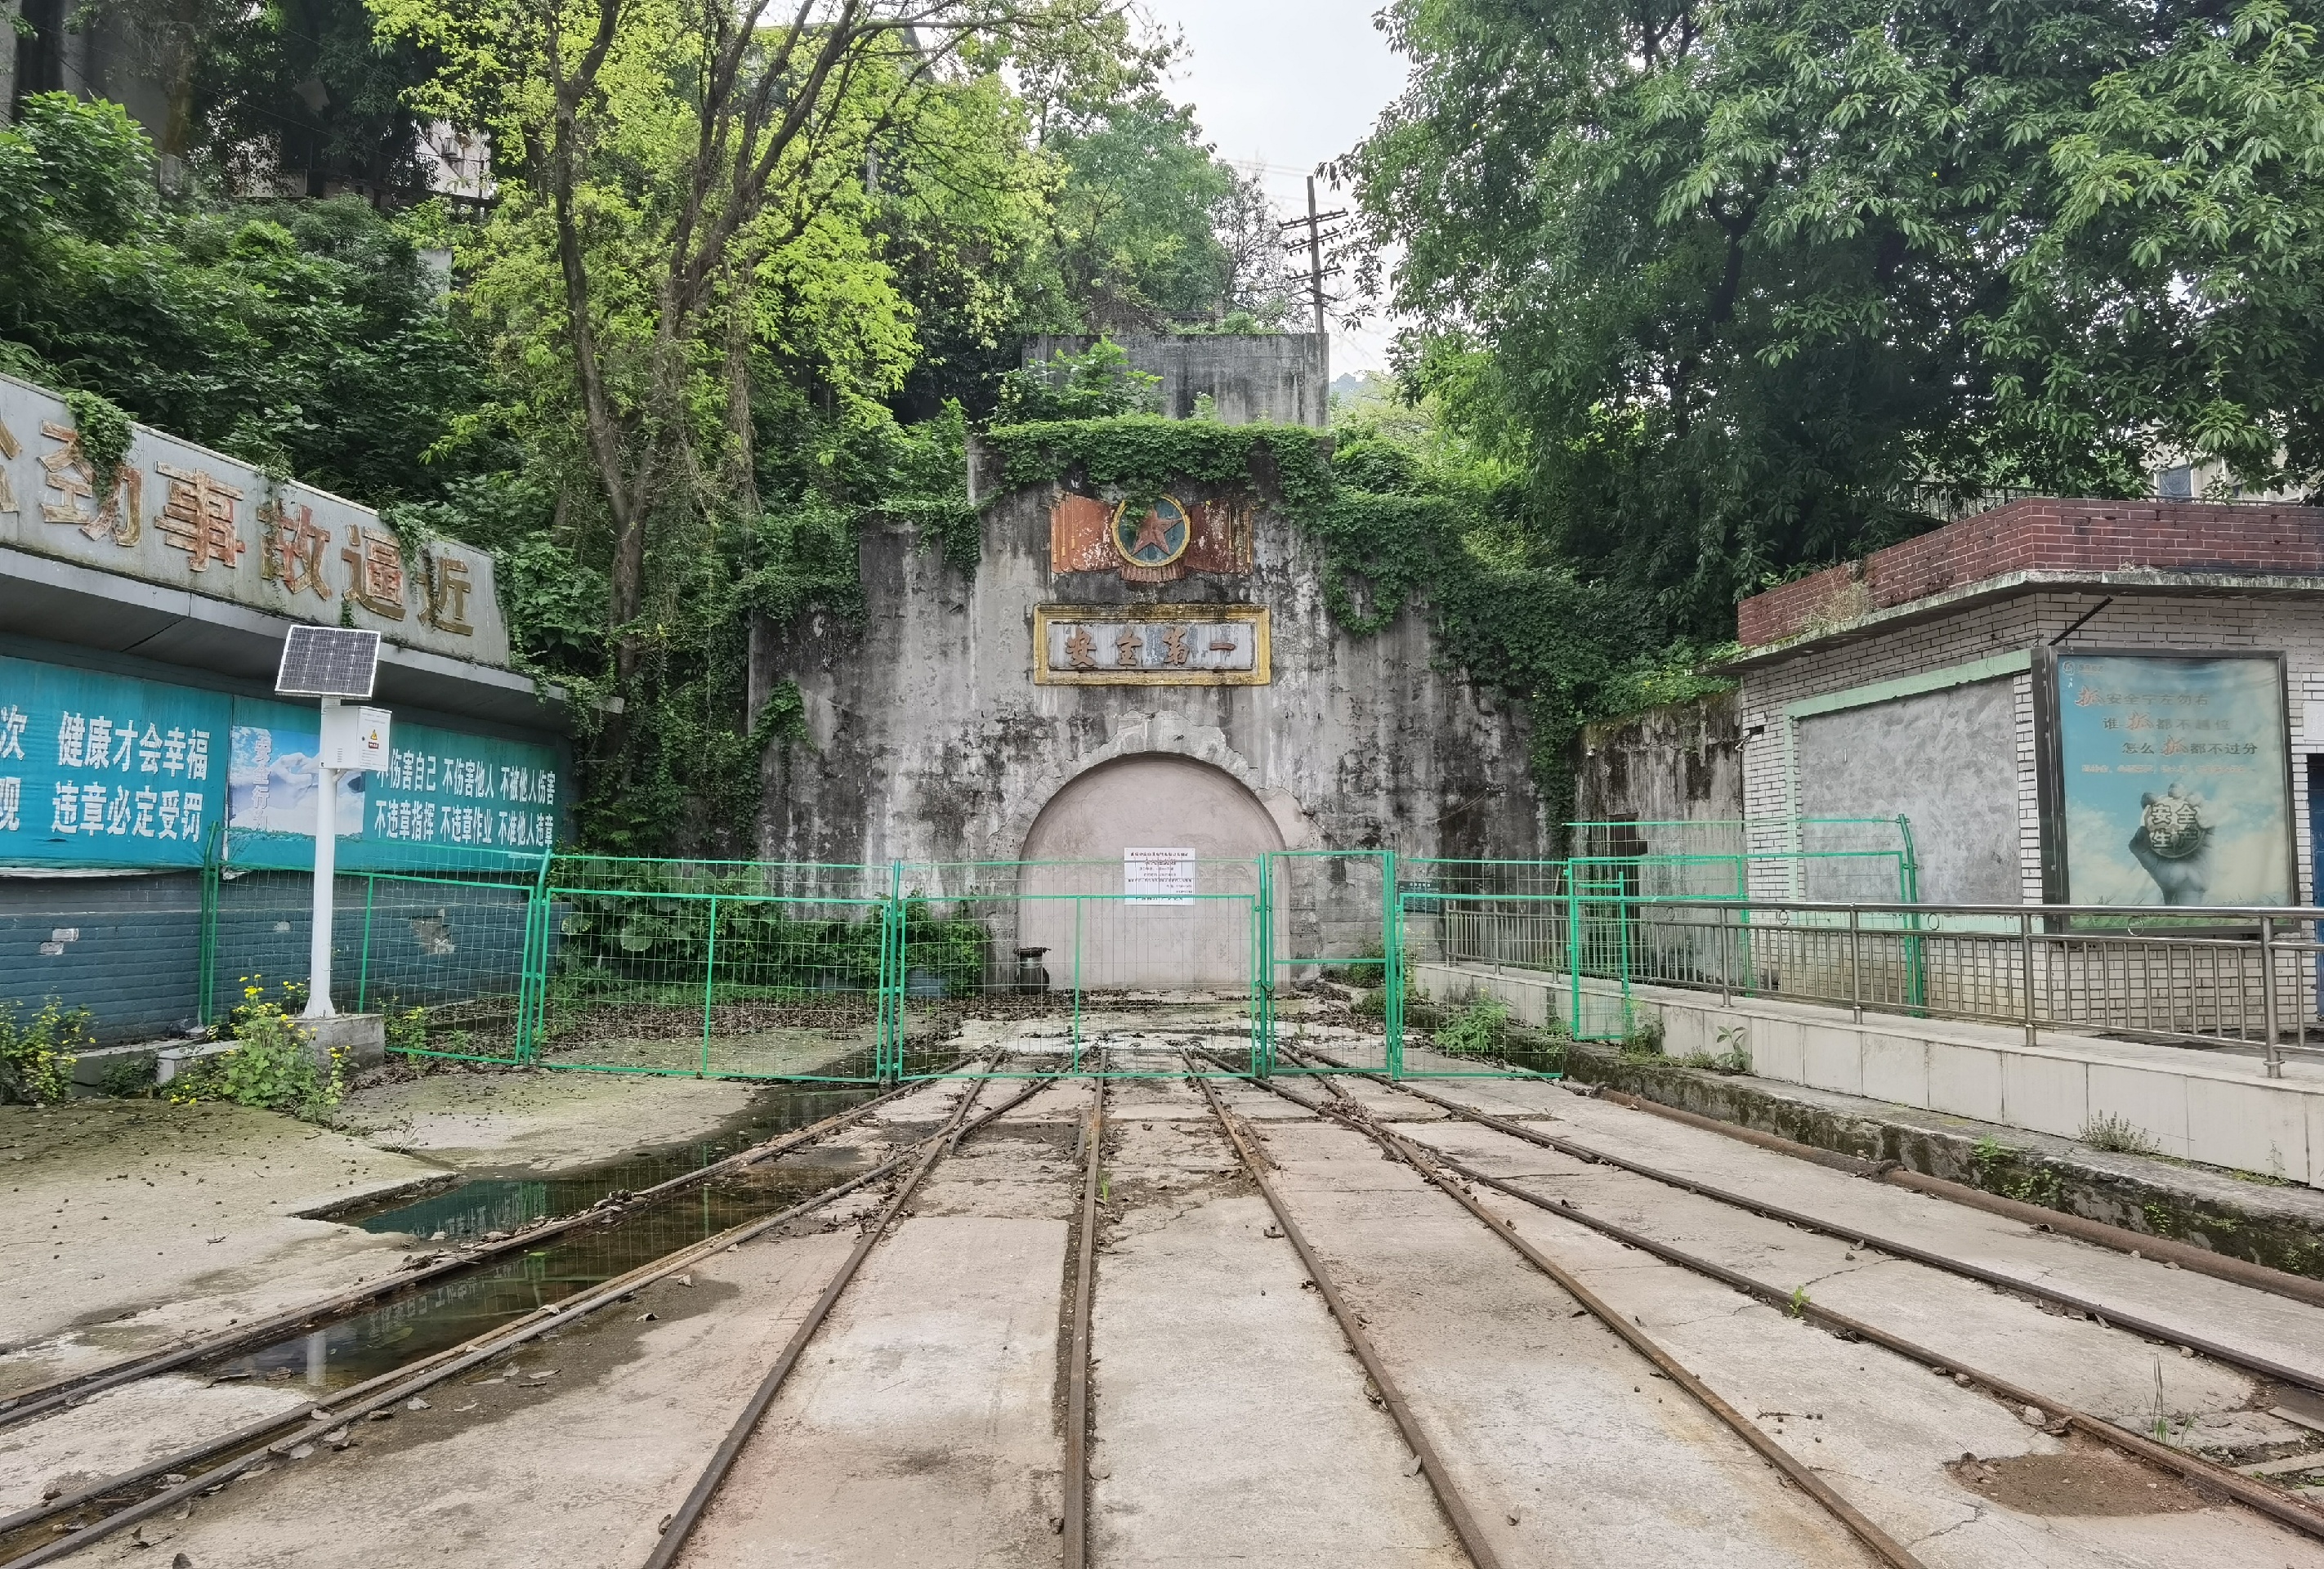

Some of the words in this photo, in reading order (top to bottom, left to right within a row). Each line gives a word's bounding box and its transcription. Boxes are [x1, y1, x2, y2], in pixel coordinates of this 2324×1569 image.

[1066, 627, 1236, 666] 安全第一
[58, 710, 210, 780] 健康才会幸福
[2122, 735, 2258, 756] 怎么抓都不过分
[442, 757, 494, 798] 不伤害他人
[500, 765, 556, 806] 不被他人伤害
[51, 780, 203, 843] 违章必定受罚
[374, 798, 436, 843] 不违章指挥
[440, 804, 493, 845] 不违章作业
[498, 810, 554, 847] 不准他人违章
[2152, 803, 2197, 825] 安全
[2152, 827, 2198, 848] 生产
